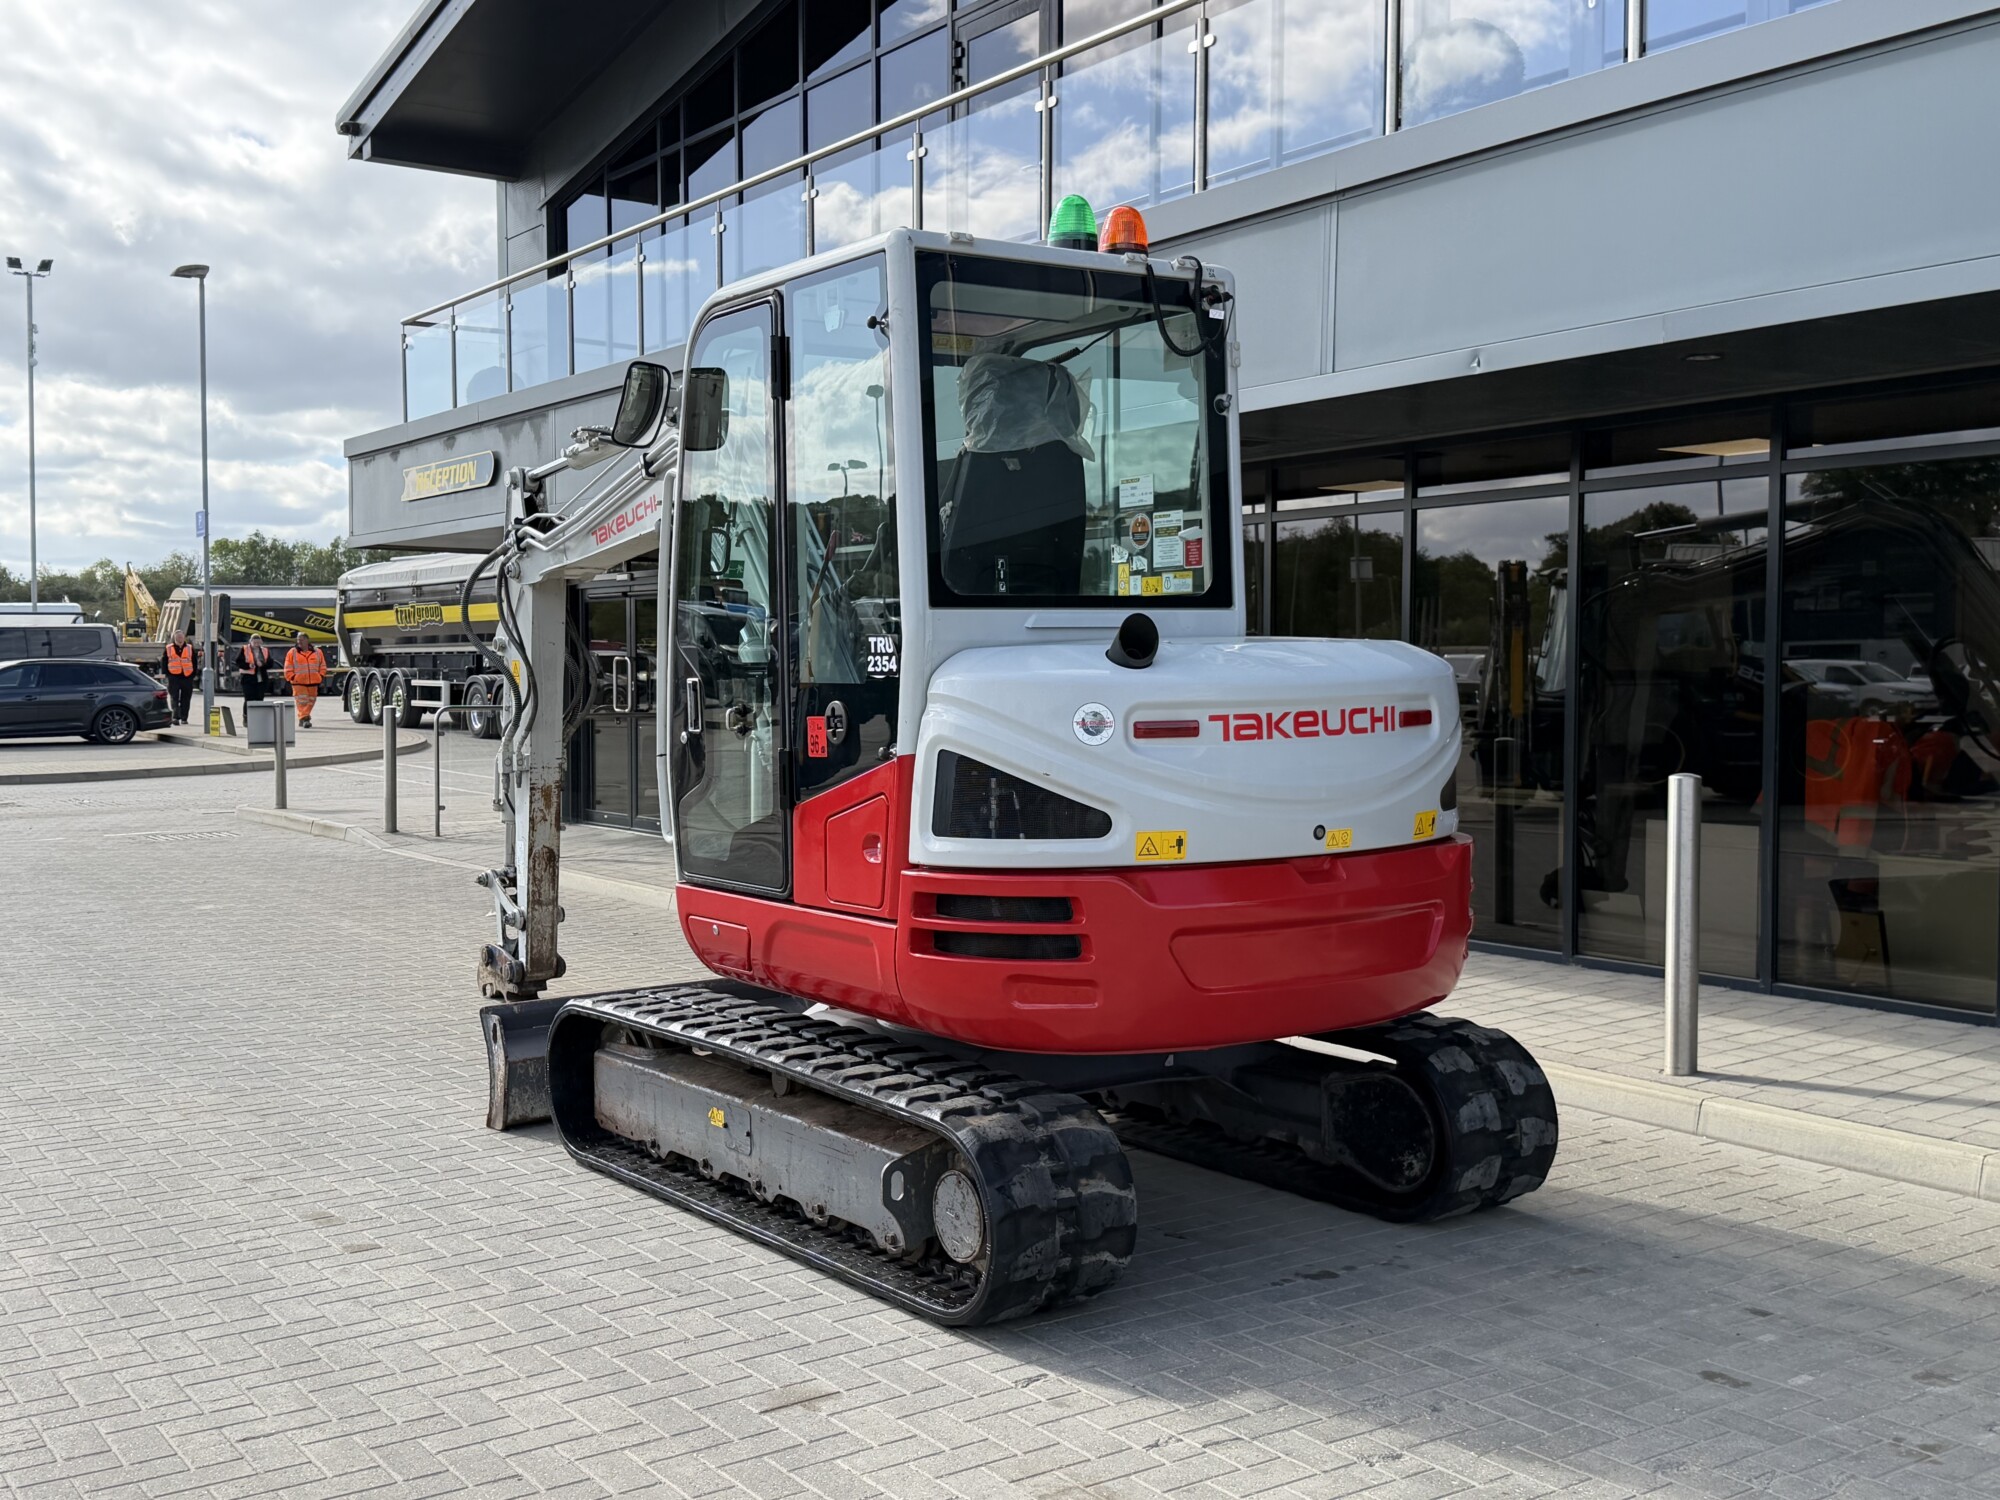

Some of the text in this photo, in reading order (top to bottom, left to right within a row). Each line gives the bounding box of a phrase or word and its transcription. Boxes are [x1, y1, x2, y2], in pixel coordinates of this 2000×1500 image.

[415, 460, 477, 492] RECEPTION
[591, 494, 657, 546] TAKEUCHI
[259, 623, 296, 637] MIX
[868, 636, 894, 654] TRU
[867, 655, 897, 672] 2354
[1208, 705, 1396, 742] TAKEUCHI
[810, 734, 820, 754] 96
